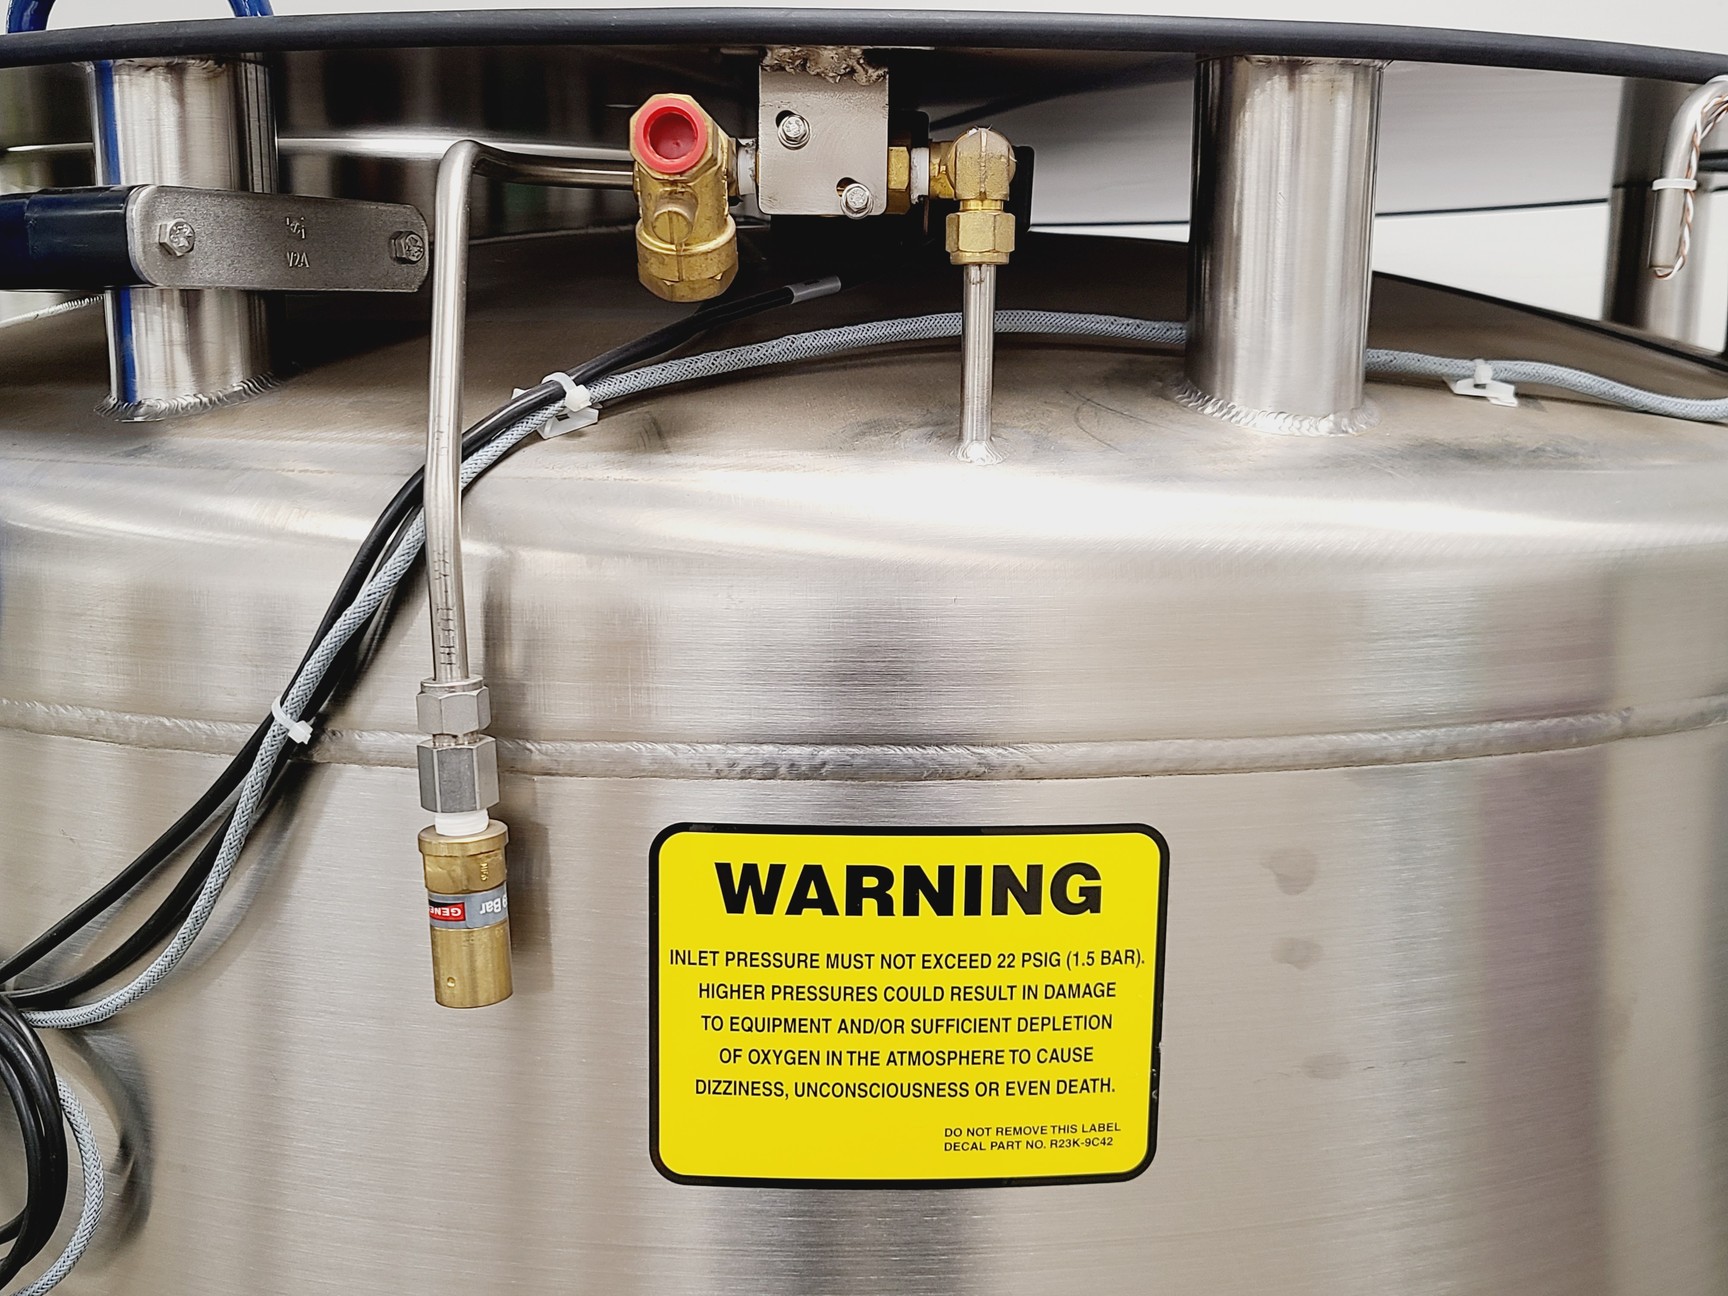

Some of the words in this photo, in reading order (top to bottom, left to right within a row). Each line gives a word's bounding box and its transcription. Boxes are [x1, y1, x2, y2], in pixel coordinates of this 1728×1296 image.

[714, 861, 1102, 917] WARNING
[428, 905, 462, 917] GENE
[479, 897, 502, 915] Bar
[670, 949, 720, 967] INLET
[725, 951, 820, 969] PRESSURE
[826, 953, 876, 970] MUST
[880, 953, 917, 970] NOT
[921, 953, 992, 970] EXCEED
[997, 952, 1016, 969] 22
[1021, 951, 1061, 968] PSIG
[1066, 951, 1095, 971] (1.5
[1100, 948, 1145, 967] BAR).
[699, 982, 765, 1001] HIGHER
[771, 984, 878, 1002] PRESSURES
[883, 985, 945, 1003] COULD
[950, 984, 1018, 1002] RESULT
[1022, 984, 1038, 1001] IN
[1044, 981, 1117, 1000] DAMAGE
[700, 1015, 724, 1032] TO
[729, 1016, 833, 1034] EQUIPMENT
[837, 1018, 905, 1035] AND/OR
[910, 1017, 1012, 1035] SUFFICIENT
[1017, 1013, 1113, 1033] DEPLETION
[719, 1047, 743, 1064] OF
[748, 1048, 820, 1066] OXYGEN
[826, 1050, 843, 1066] IN
[846, 1050, 881, 1067] THE
[885, 1049, 1005, 1067] ATMOSPHERE
[1008, 1048, 1031, 1065] TO
[1036, 1046, 1094, 1064] CAUSE
[695, 1079, 789, 1100] DIZZINESS,
[794, 1081, 970, 1099] UNCONSCIOUSNESS
[975, 1081, 1000, 1098] OR
[1005, 1079, 1051, 1097] EVEN
[1056, 1077, 1115, 1095] DEATH.
[944, 1127, 962, 1138] DO
[966, 1126, 993, 1137] NOT
[995, 1125, 1048, 1137] REMOVE
[1050, 1124, 1078, 1135] THIS
[1081, 1122, 1121, 1134] LABEL
[944, 1141, 987, 1152] DECAL
[990, 1140, 1023, 1151] PART
[1025, 1139, 1046, 1150] NO.
[1049, 1136, 1114, 1149] R23K-9C42
